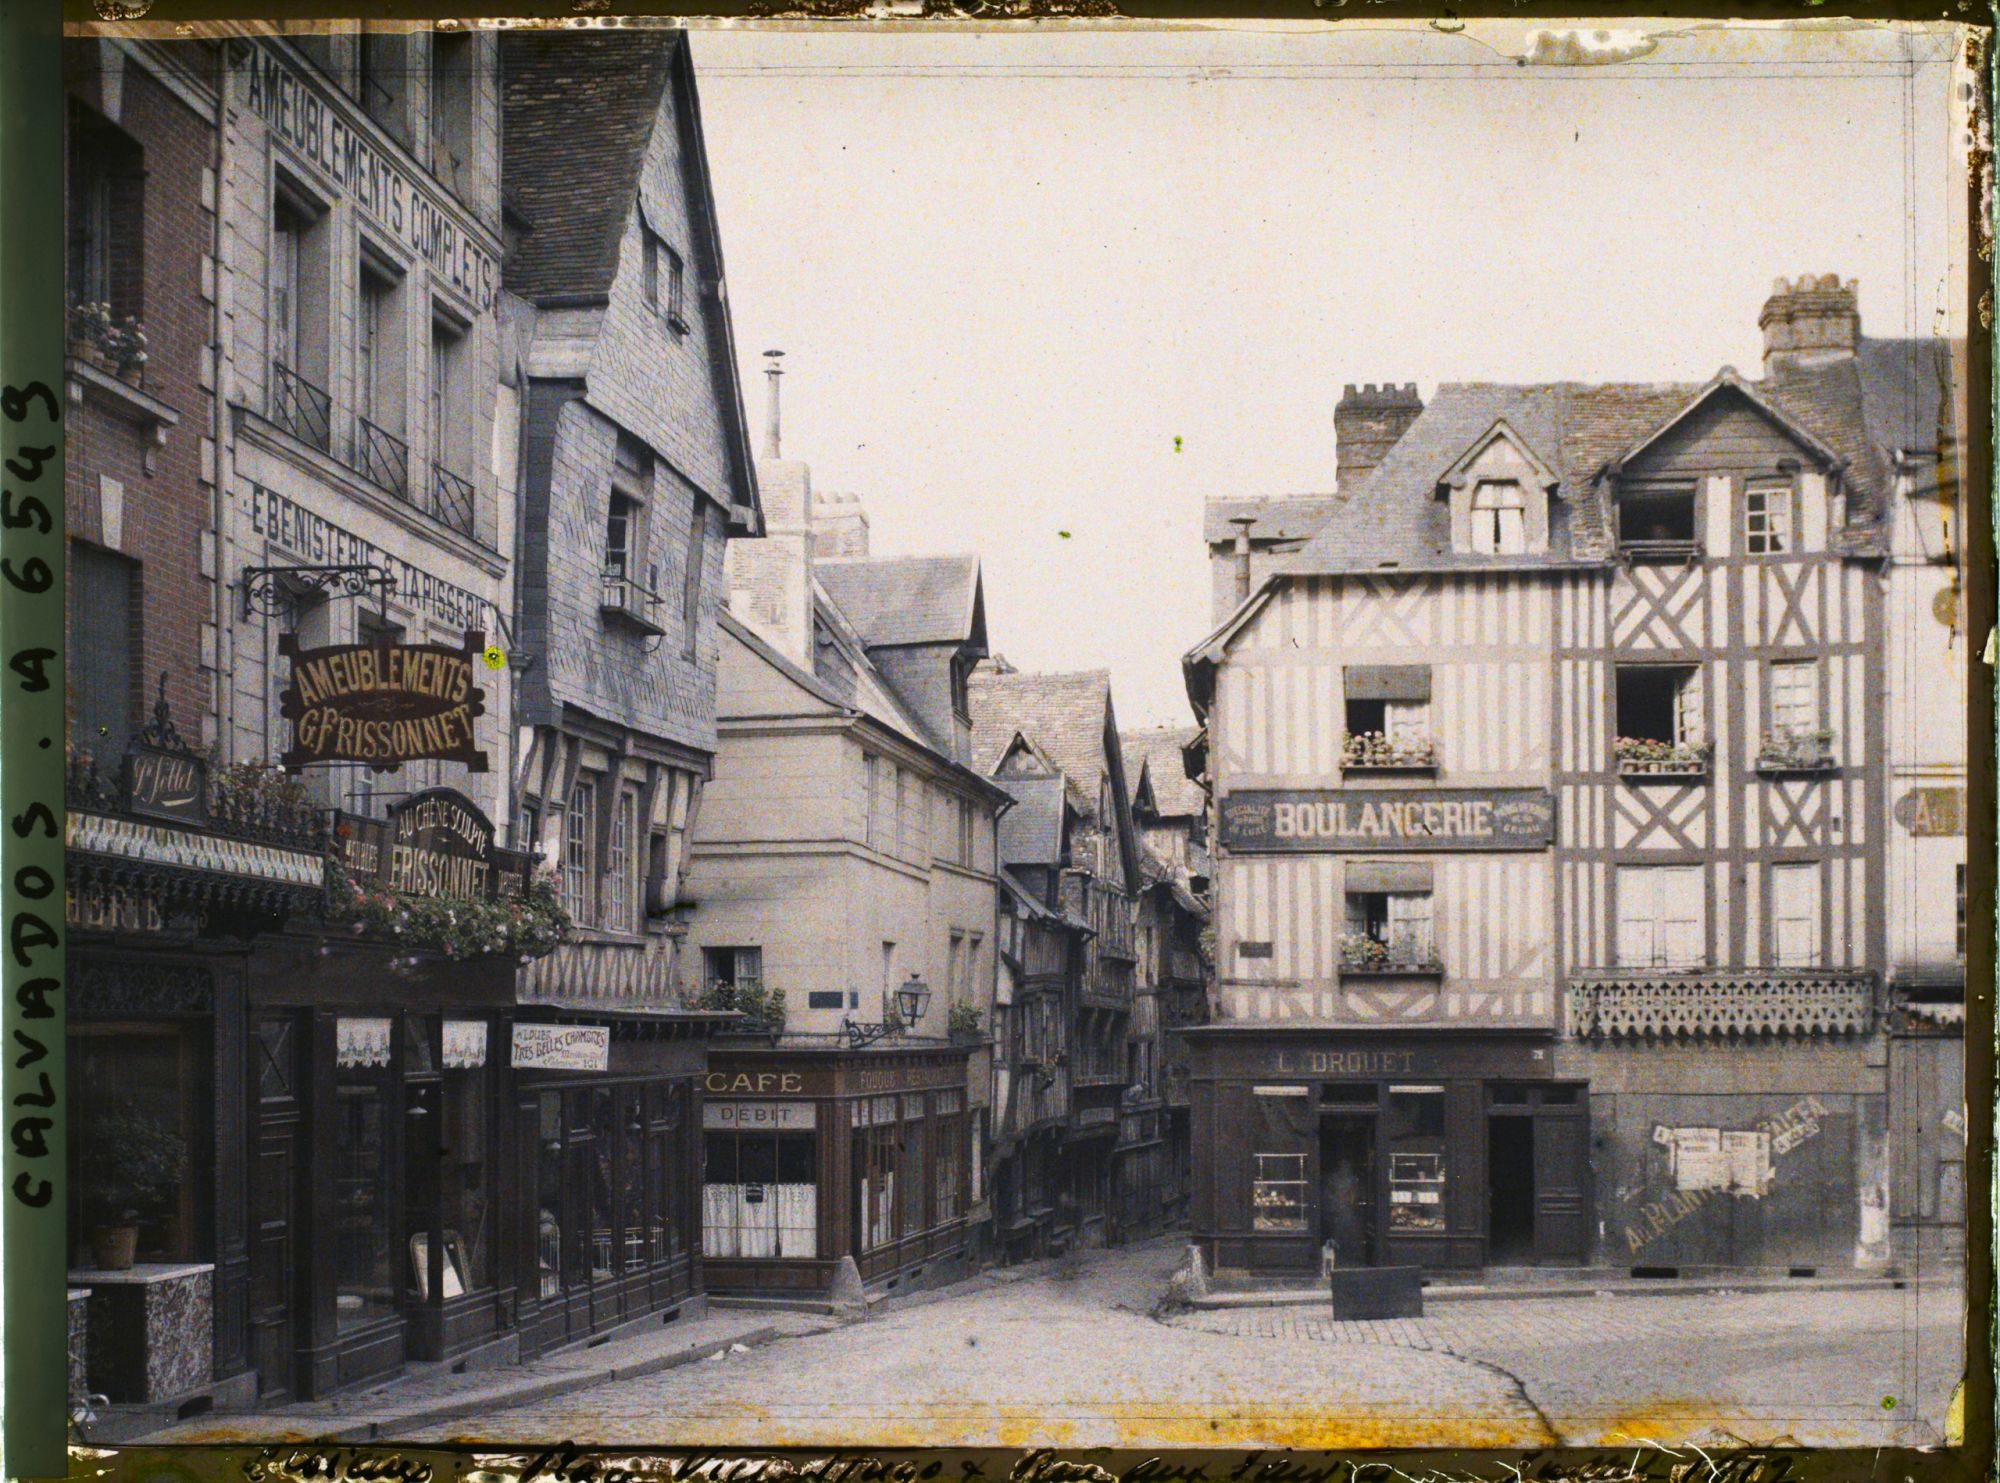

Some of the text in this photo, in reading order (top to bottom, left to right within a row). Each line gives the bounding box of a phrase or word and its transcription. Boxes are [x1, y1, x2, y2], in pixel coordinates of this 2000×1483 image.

[249, 45, 492, 312] AMEUBLEMENTS COMPLETS
[9, 647, 58, 692] A
[295, 650, 472, 705] AMEUBLEMENTS
[399, 808, 413, 842] AU
[416, 797, 449, 831] CHÊNE
[1274, 801, 1494, 838] BOULANGERIE
[391, 844, 490, 900] FRISSONNET
[11, 801, 60, 1208] CALVADOS
[1311, 1051, 1415, 1073] DROUET
